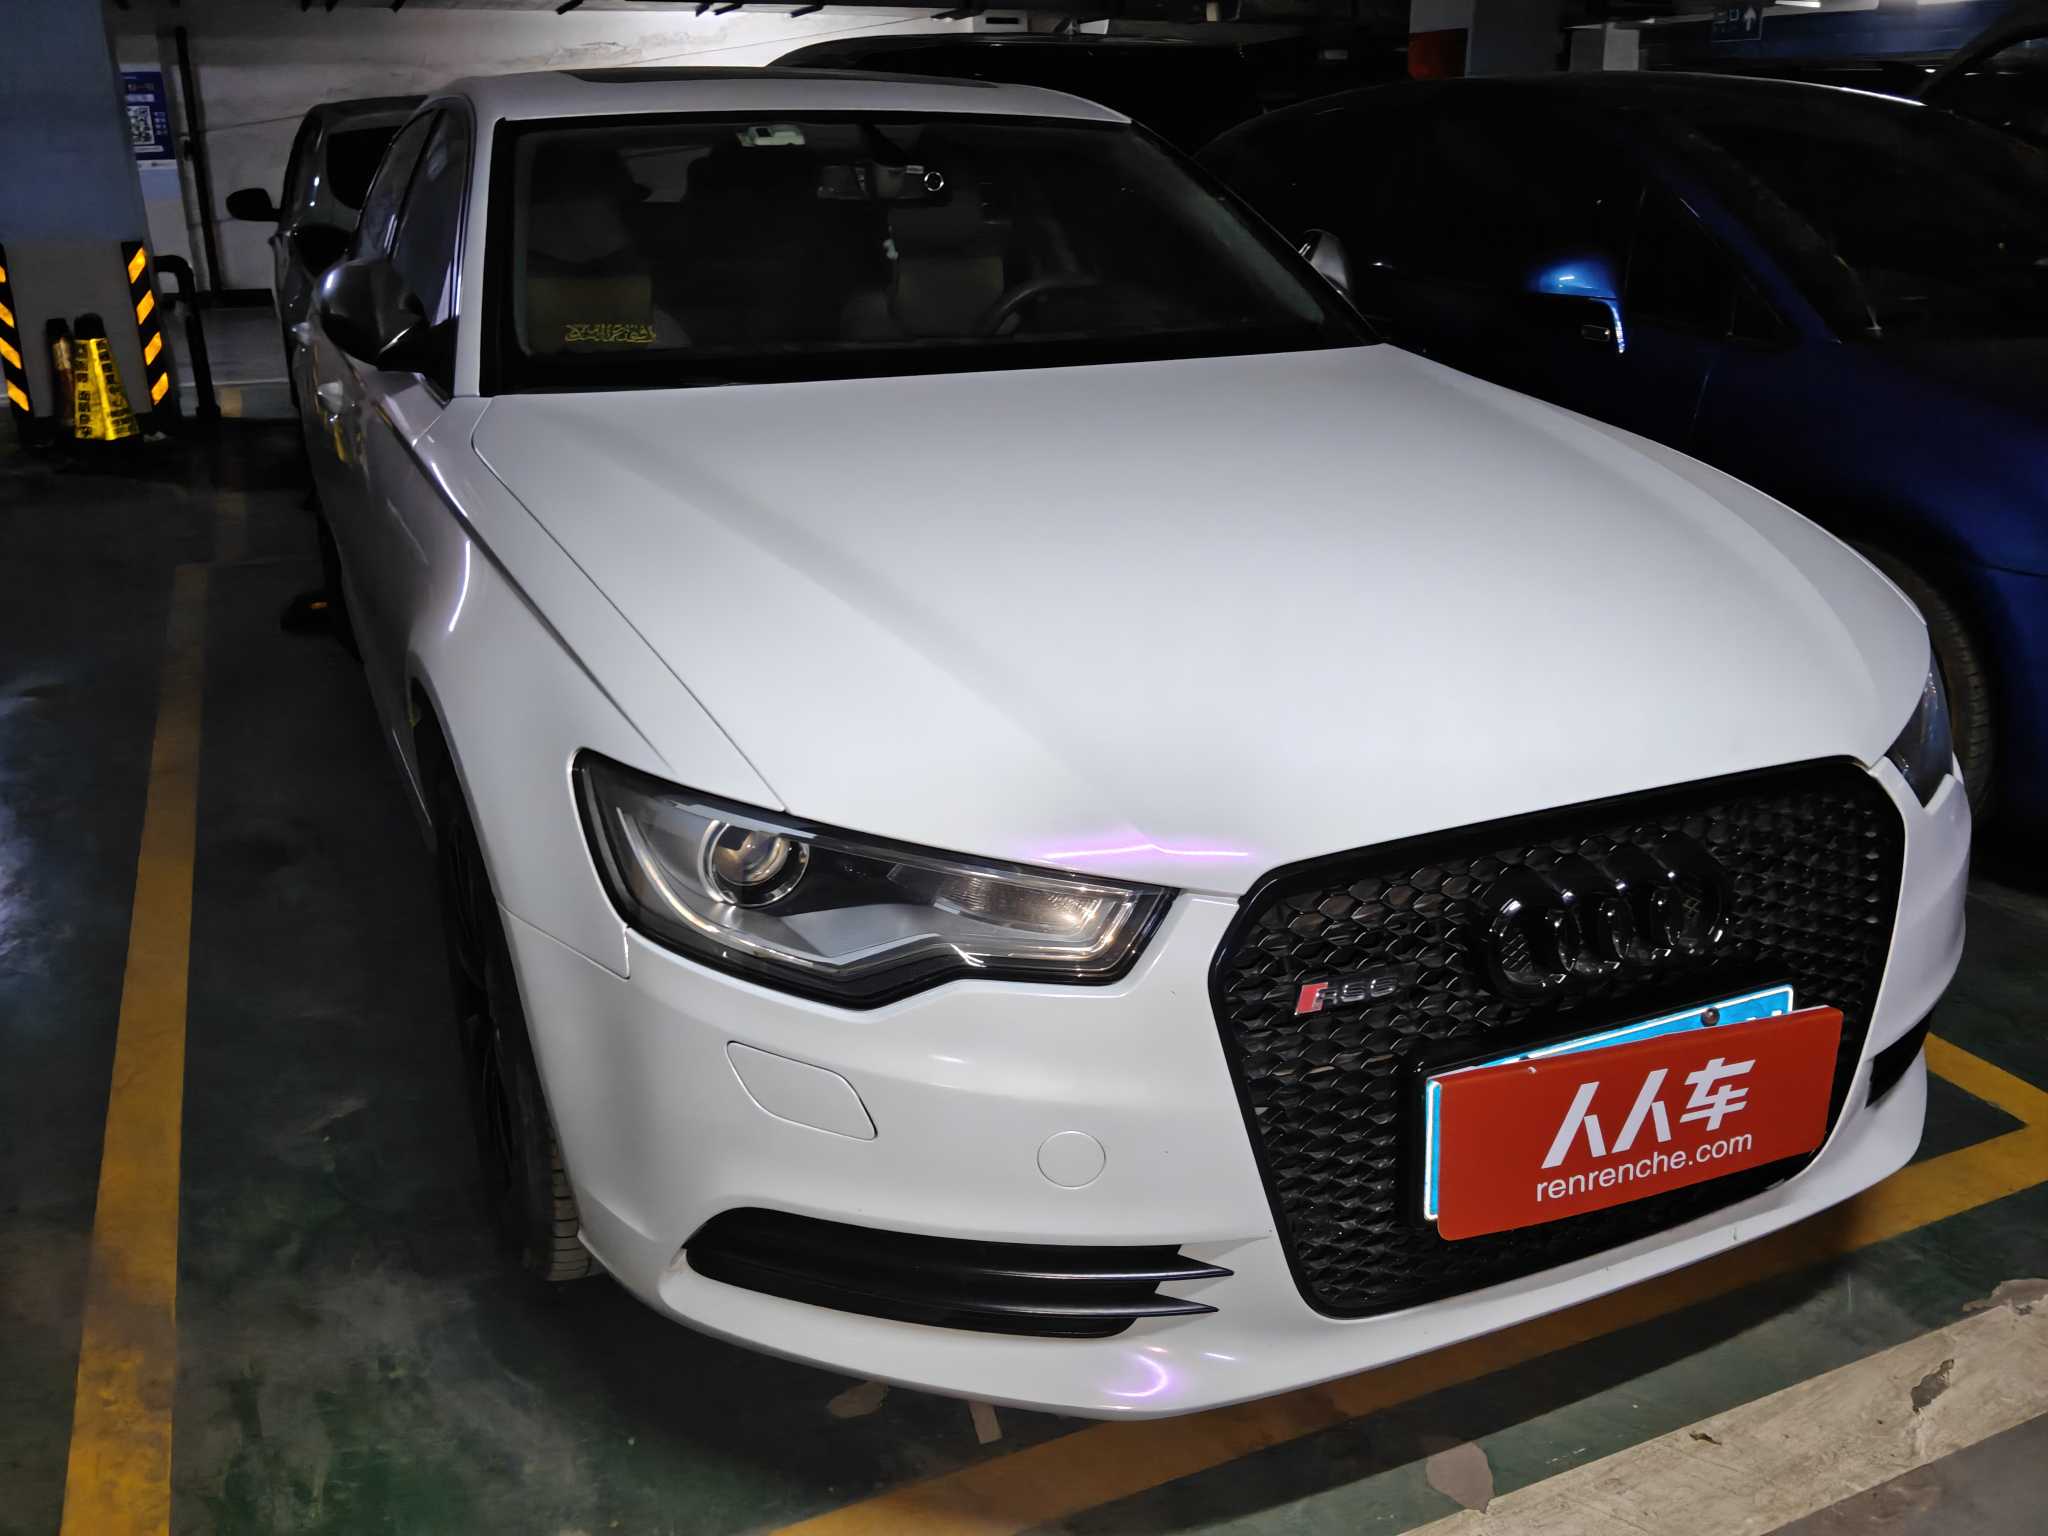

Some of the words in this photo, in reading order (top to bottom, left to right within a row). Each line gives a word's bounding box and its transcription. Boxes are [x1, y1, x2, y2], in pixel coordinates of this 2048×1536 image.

[1541, 1057, 1756, 1169] 人人车
[1536, 1131, 1753, 1202] renrenche.com
